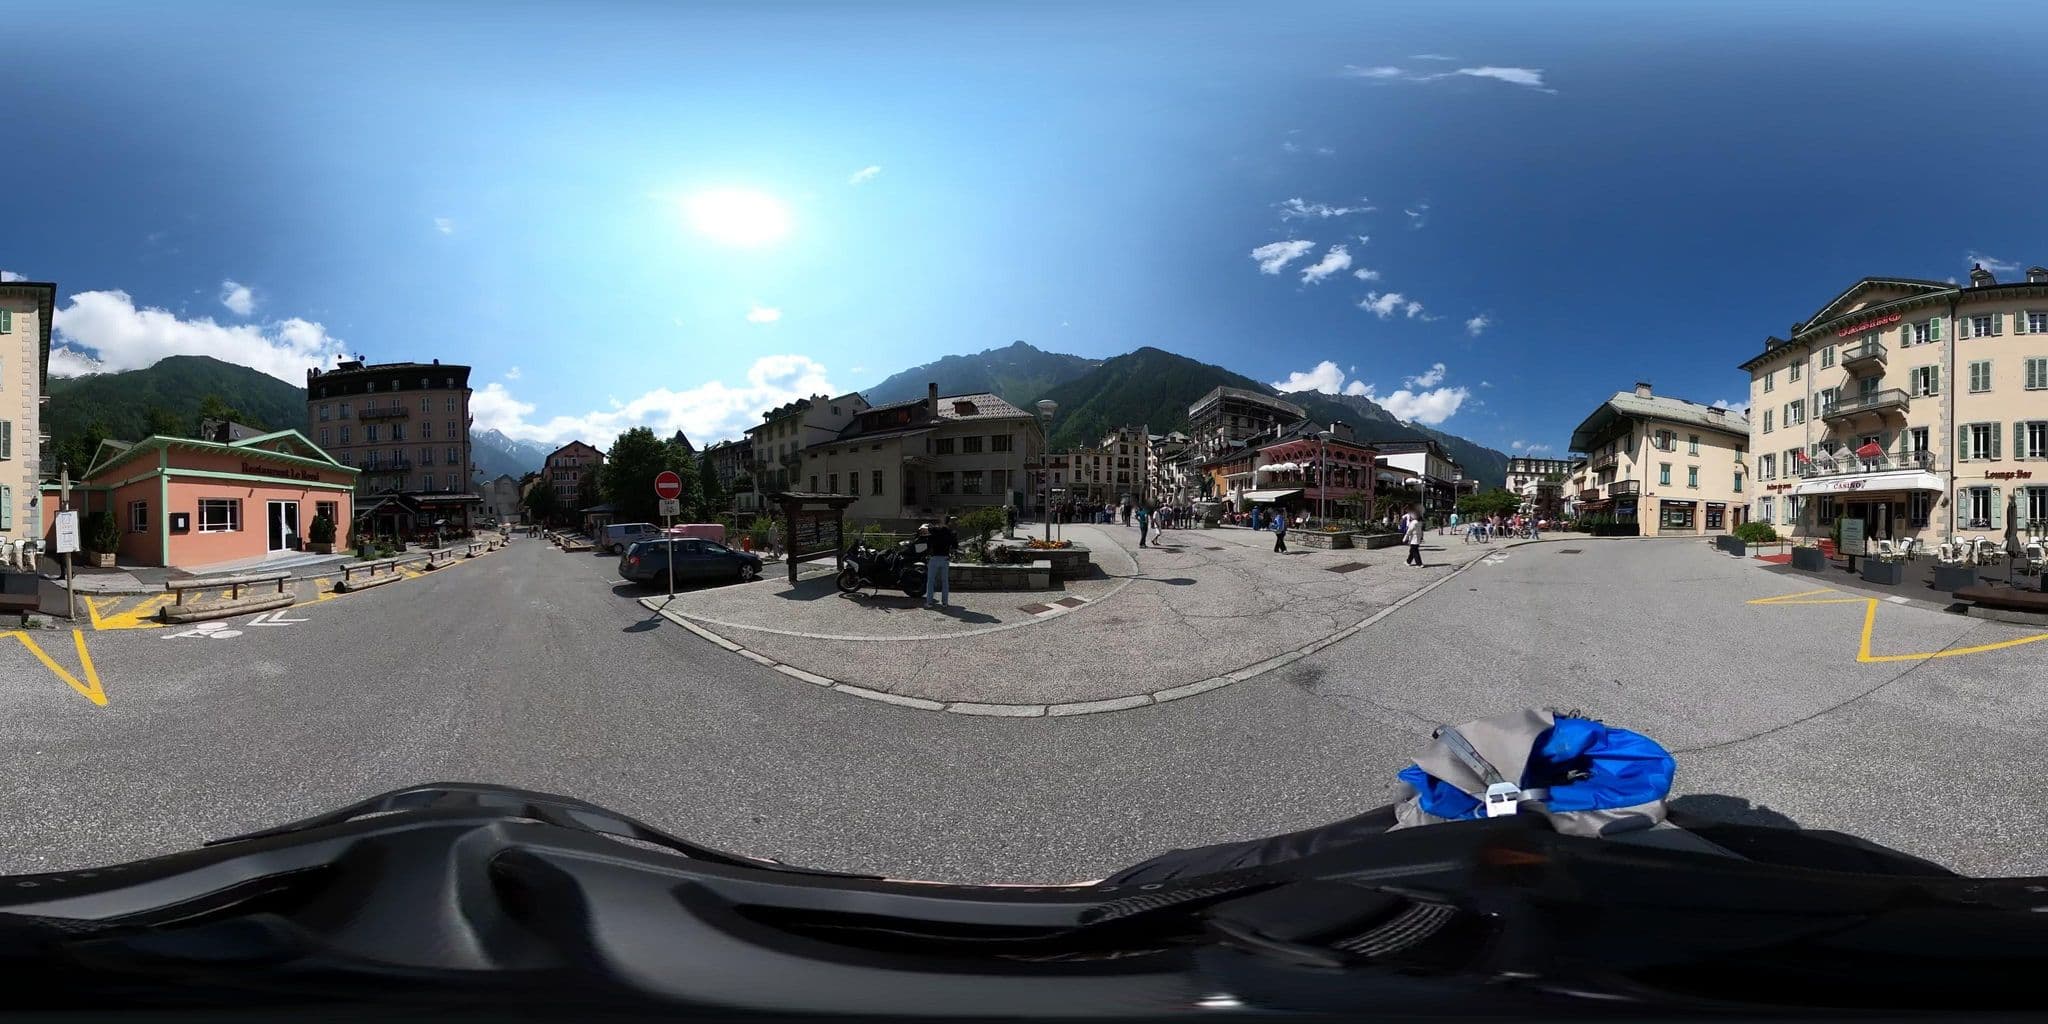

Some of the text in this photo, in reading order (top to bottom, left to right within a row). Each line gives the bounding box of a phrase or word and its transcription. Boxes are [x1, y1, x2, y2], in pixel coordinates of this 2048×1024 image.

[1839, 313, 1901, 337] CASINO
[1985, 469, 2032, 481] Lounge Bar
